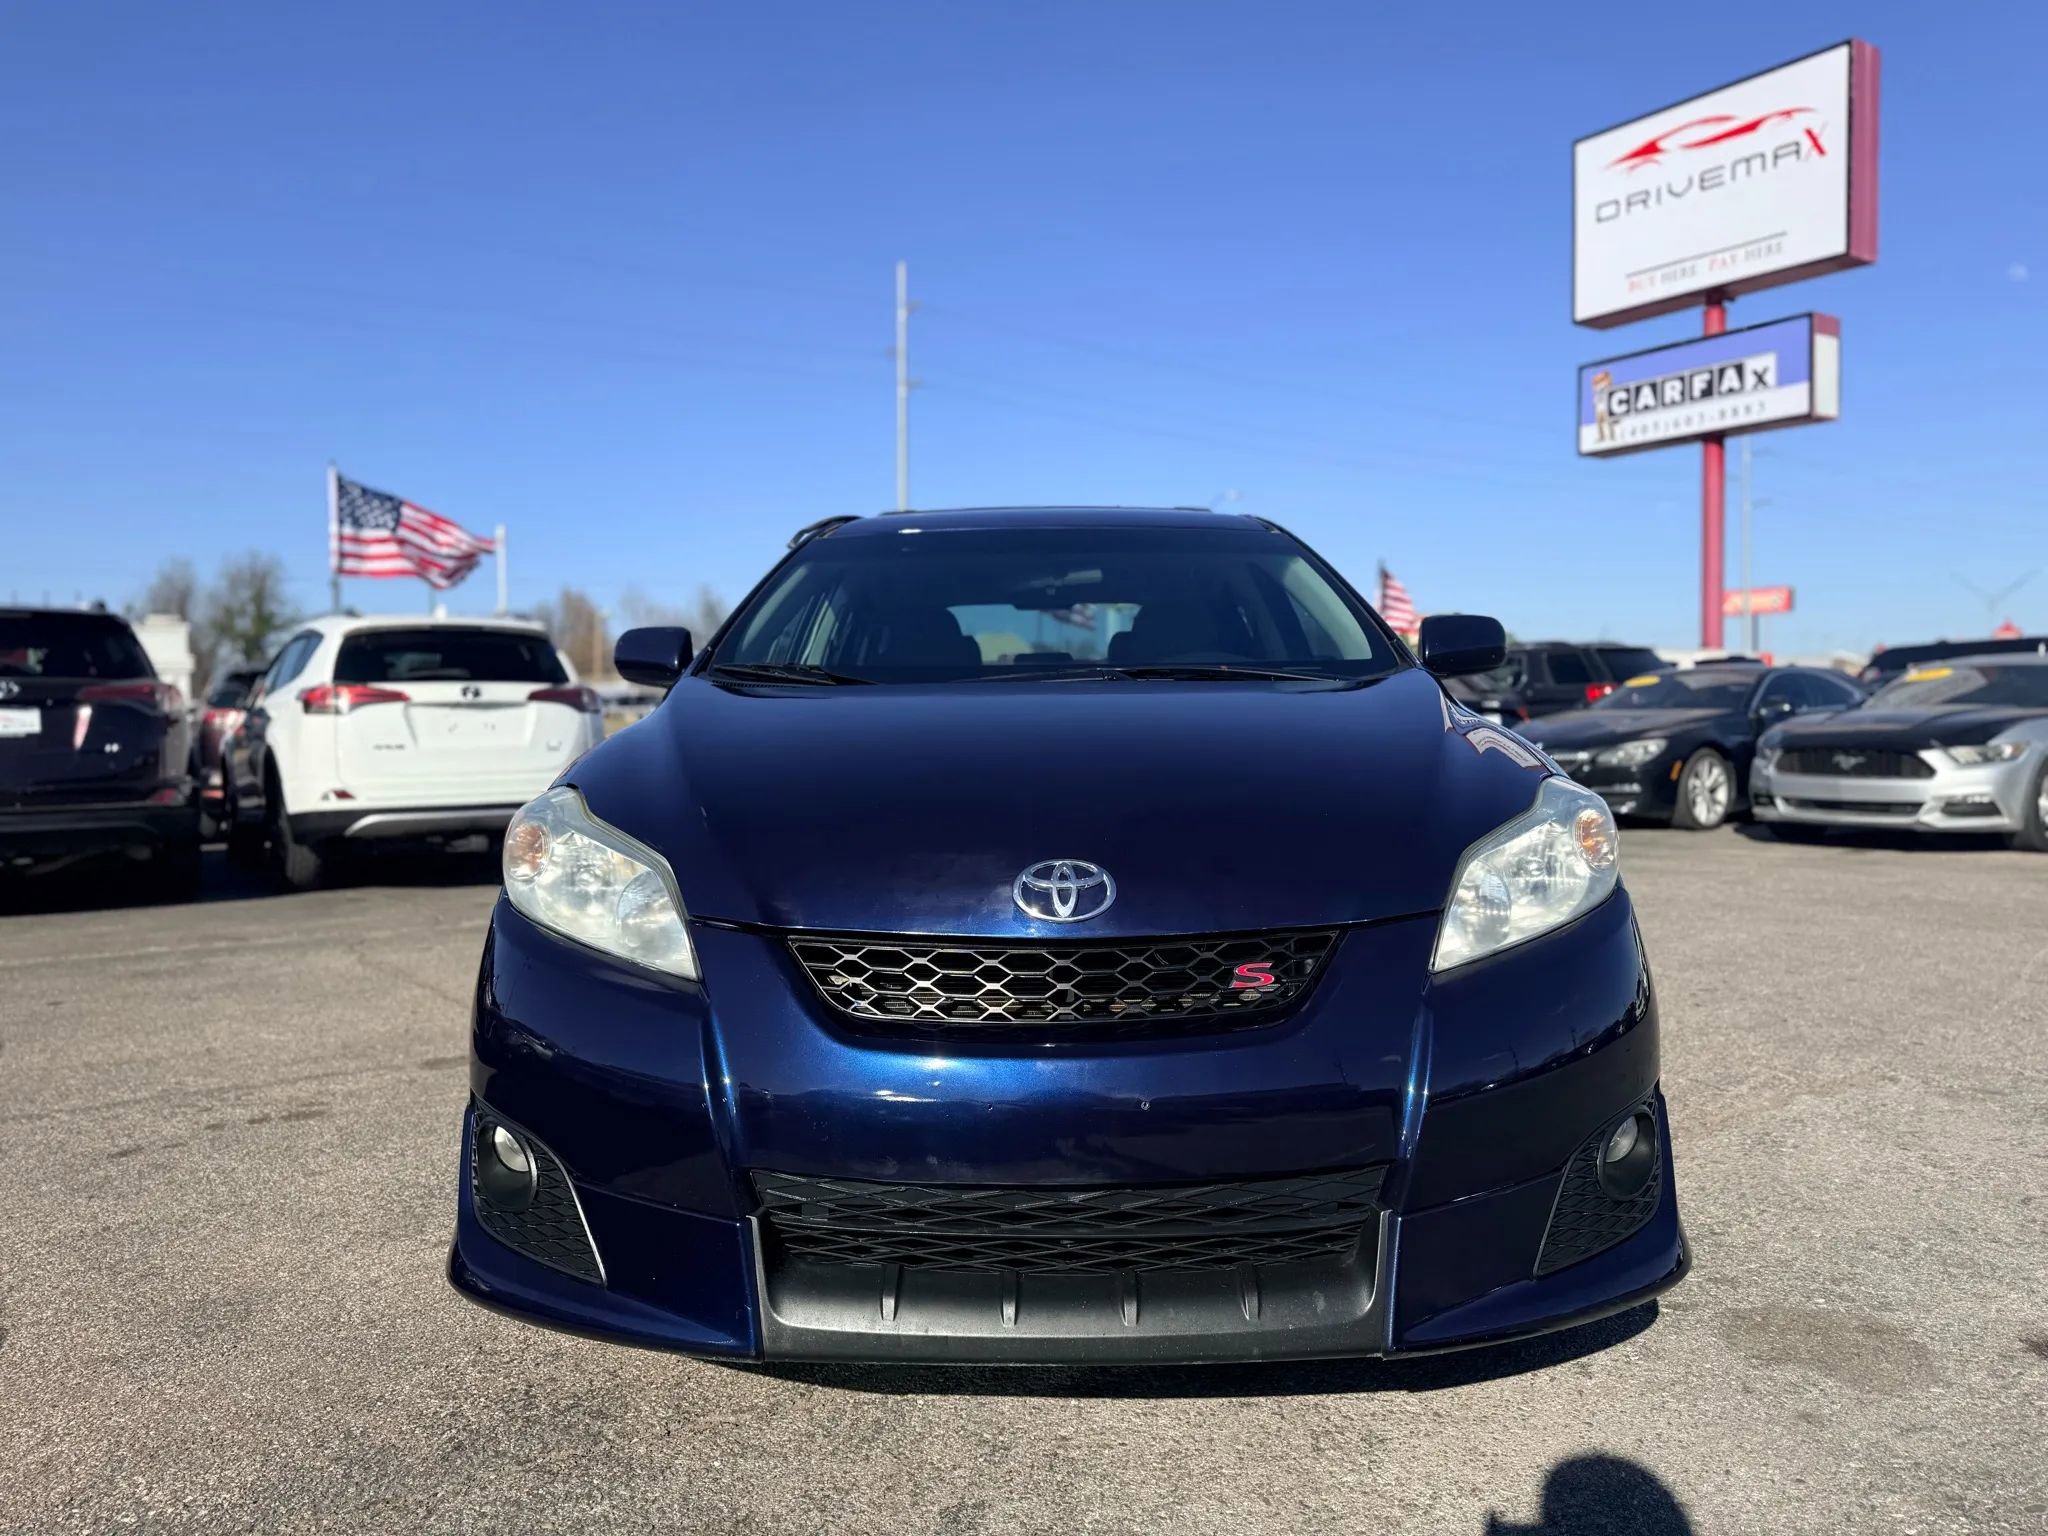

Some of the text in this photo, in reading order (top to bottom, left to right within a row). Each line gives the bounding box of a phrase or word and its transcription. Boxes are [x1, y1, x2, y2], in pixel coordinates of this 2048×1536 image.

[1594, 122, 1828, 224] DRIVEMAX
[1609, 362, 1771, 416] CARFAX
[1229, 962, 1275, 988] S
